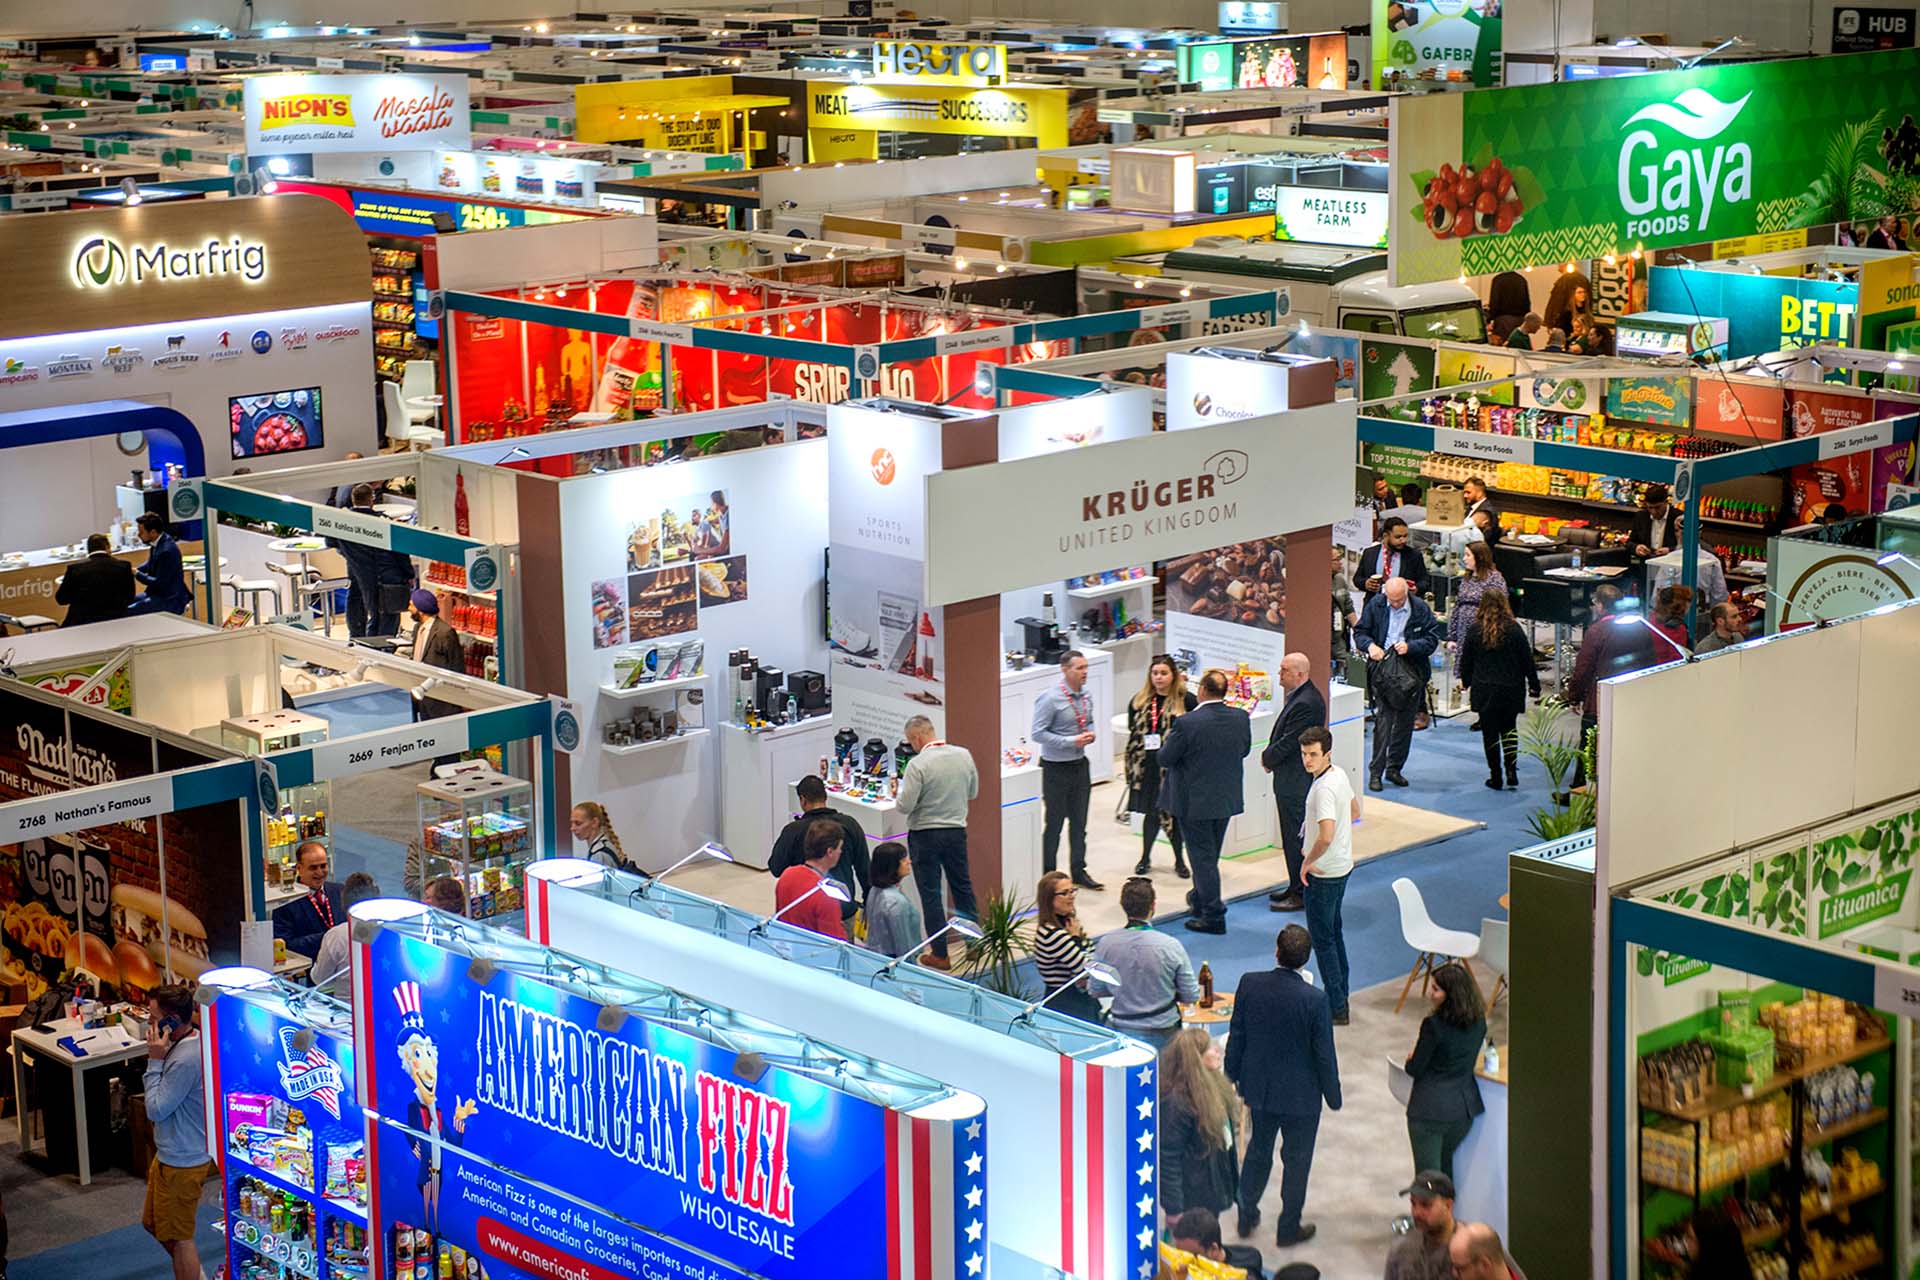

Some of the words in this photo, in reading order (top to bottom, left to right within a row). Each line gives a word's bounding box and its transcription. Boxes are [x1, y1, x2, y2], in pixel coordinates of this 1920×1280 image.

[1869, 16, 1907, 33] HUB
[815, 94, 848, 116] MEAT
[941, 99, 1029, 124] SUCCESSORS
[1617, 129, 1753, 232] Gaya
[460, 203, 511, 230] 250+
[1302, 198, 1367, 215] MEATLESS
[1316, 213, 1351, 227] FARM
[1626, 213, 1690, 240] FOODS
[135, 239, 266, 281] Marfrig
[1781, 294, 1858, 339] BETT
[49, 363, 93, 376] MONTANA
[1371, 453, 1384, 463] TOP
[1391, 456, 1406, 467] RICE
[1473, 442, 1492, 453] Surya
[1493, 445, 1512, 455] Foods
[1082, 471, 1215, 522] KRÜGER
[362, 528, 384, 540] Noodles
[857, 527, 911, 545] NUTRITION
[866, 516, 902, 531] SPORTS
[1058, 523, 1134, 554] UNITED
[1144, 501, 1239, 538] KINGDOM
[1813, 584, 1849, 611] CERVEZA
[17, 723, 117, 785] Nathan's
[348, 749, 374, 764] 2669
[380, 741, 415, 759] Fenjan
[416, 737, 436, 750] Tea
[0, 770, 20, 787] THE
[21, 777, 66, 797] FLAVO
[19, 815, 47, 830] 2768
[54, 804, 106, 823] Nathan's
[108, 795, 152, 812] Famous
[1823, 881, 1900, 926] Lituanica
[289, 1079, 310, 1094] MADE
[310, 1074, 319, 1085] IN
[320, 1070, 334, 1084] USA
[476, 990, 688, 1183] AMERICAN
[696, 1069, 795, 1228] FIZZ
[457, 1164, 503, 1196] American
[505, 1184, 526, 1206] Fizz
[528, 1193, 536, 1209] is
[538, 1203, 558, 1219] one
[560, 1208, 572, 1224] of
[573, 1212, 590, 1232] the
[593, 1219, 628, 1247] largest
[631, 1237, 681, 1272] importers
[684, 1264, 705, 1280] and
[462, 1187, 508, 1217] American
[510, 1212, 529, 1227] and
[531, 1217, 581, 1249] Canadian
[584, 1239, 640, 1275] Groceries,
[679, 1190, 795, 1261] WHOLESALE
